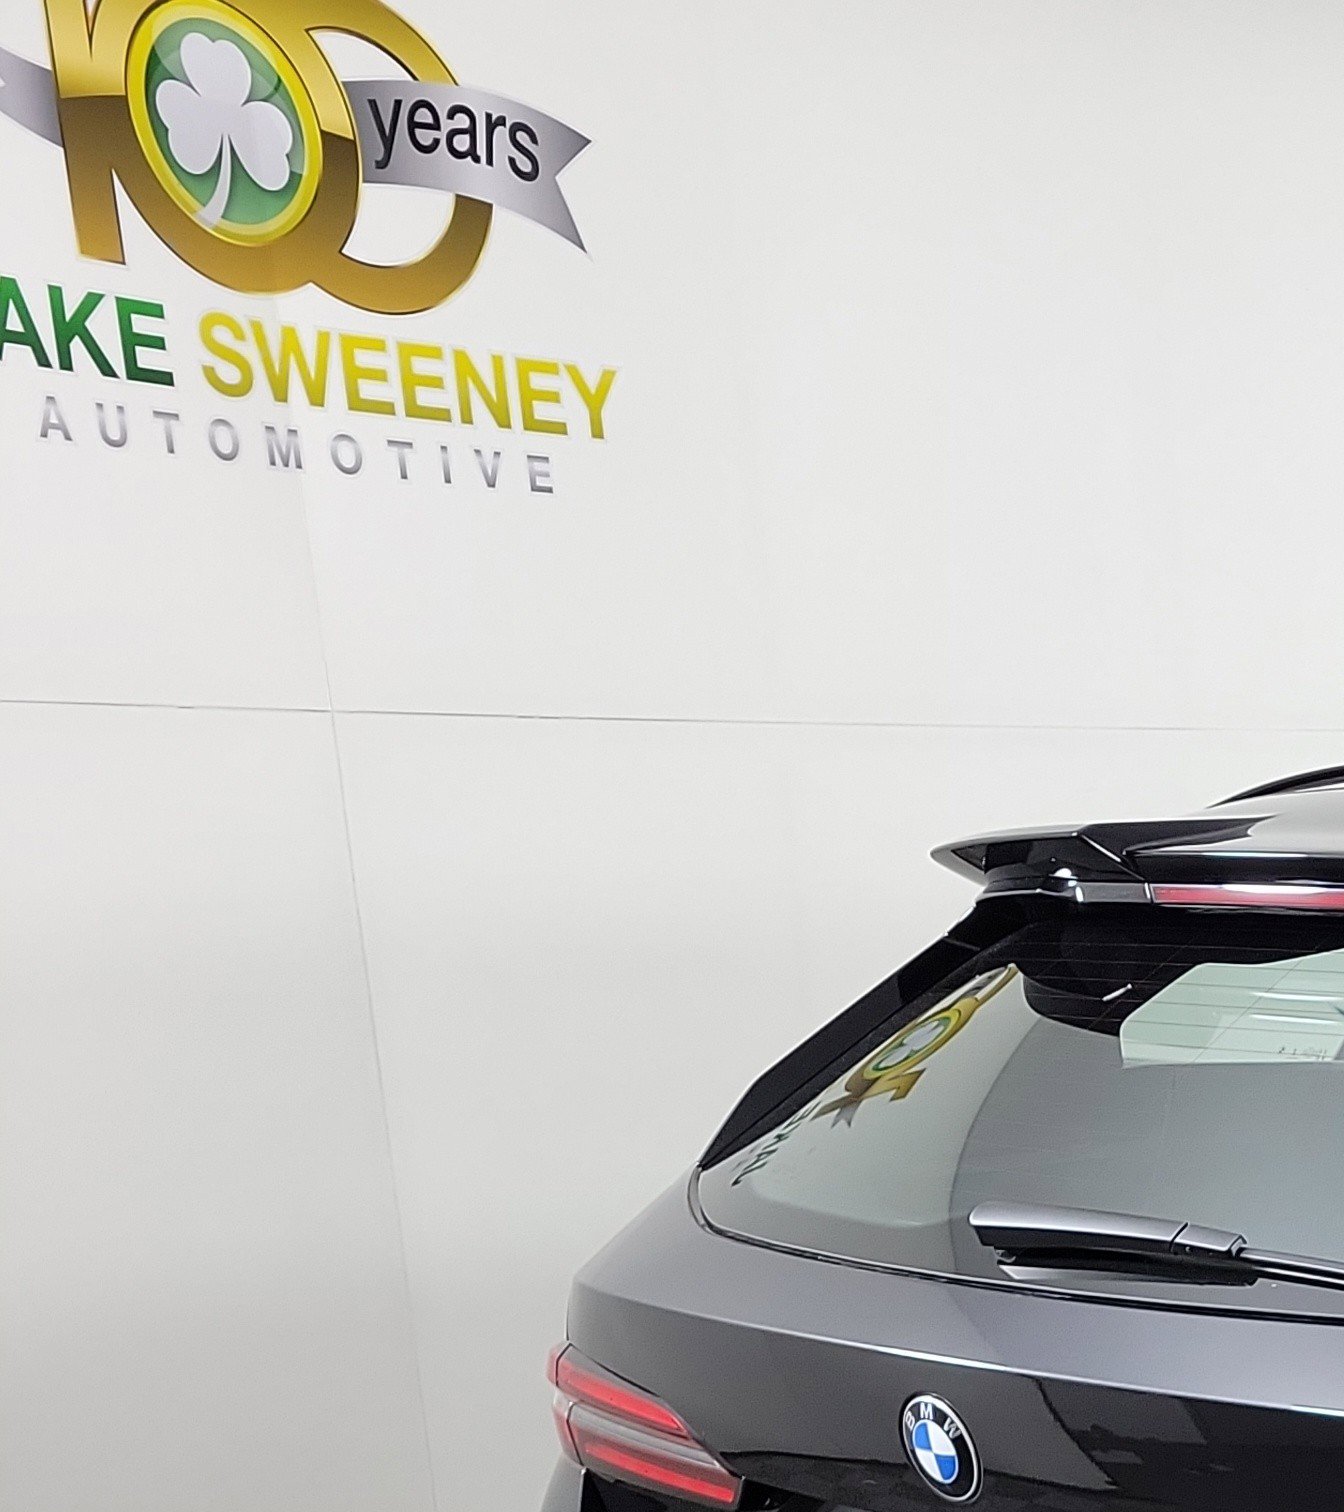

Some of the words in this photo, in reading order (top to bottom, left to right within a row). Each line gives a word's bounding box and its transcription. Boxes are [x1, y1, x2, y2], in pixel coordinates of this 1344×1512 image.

[367, 97, 540, 182] years
[0, 276, 175, 387] AKE
[199, 312, 617, 440] SWEENEY
[39, 395, 554, 494] AUTOMOTIVE
[905, 1401, 962, 1439] BMW
